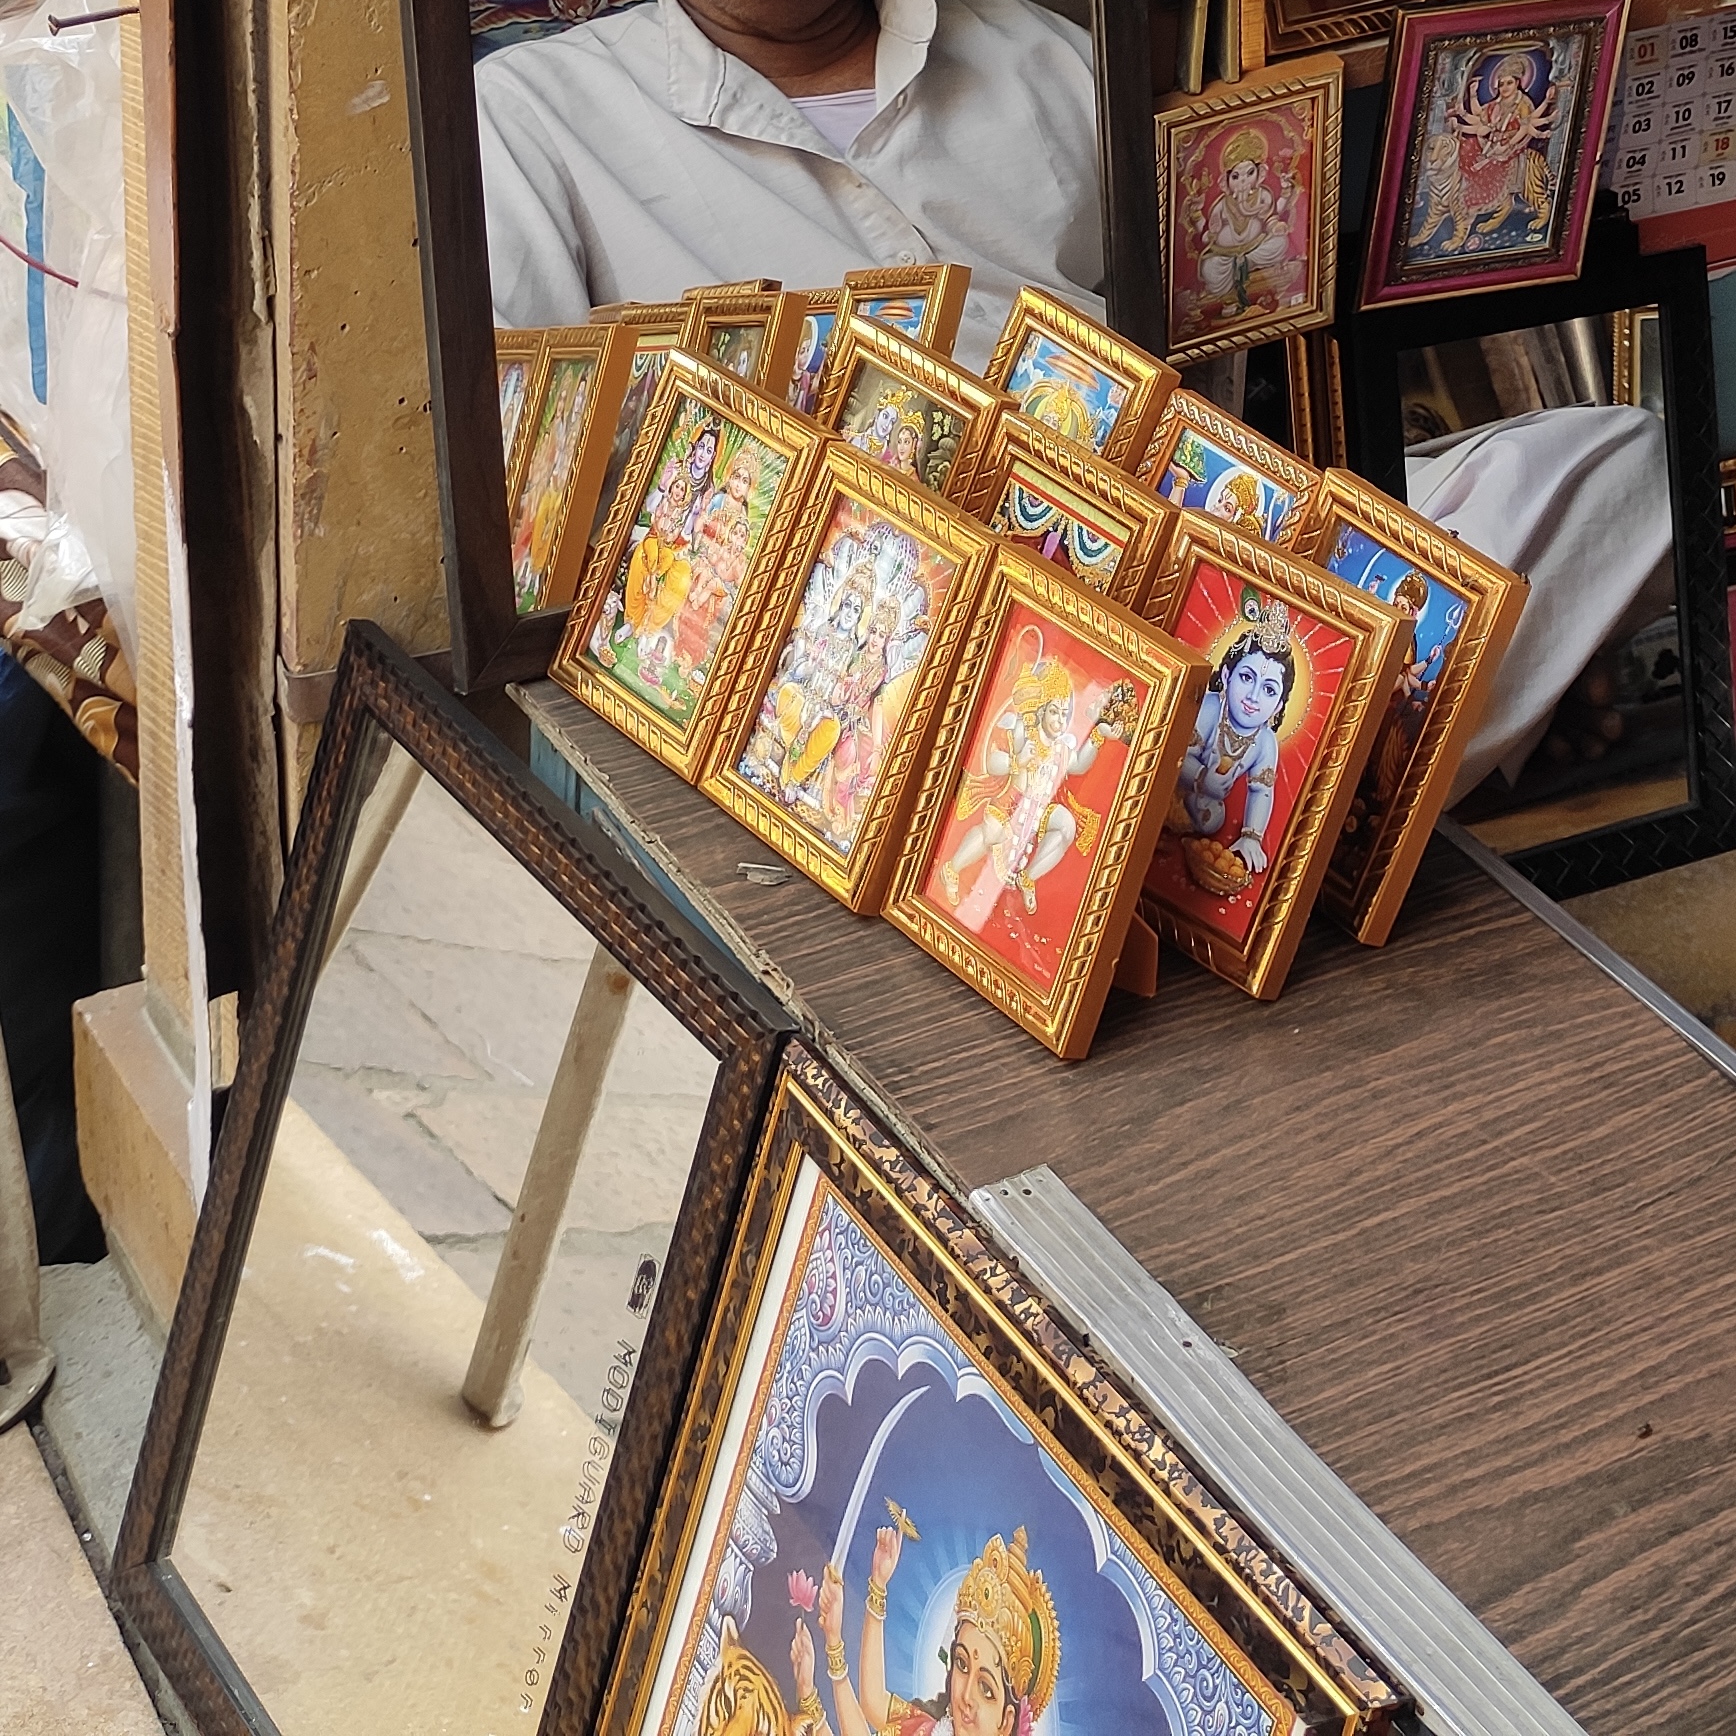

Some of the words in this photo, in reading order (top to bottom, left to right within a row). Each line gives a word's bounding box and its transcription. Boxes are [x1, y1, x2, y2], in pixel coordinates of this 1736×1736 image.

[1637, 42, 1655, 59] 01
[1680, 33, 1699, 50] 08
[1635, 80, 1655, 97] 02
[1676, 70, 1695, 88] 09
[1719, 62, 1735, 78] 16
[1632, 117, 1651, 134] 03
[1674, 108, 1692, 124] 10
[1716, 98, 1733, 115] 17
[1625, 153, 1647, 169] 04
[1670, 143, 1688, 161] 11
[1714, 134, 1731, 151] 18
[1621, 188, 1642, 205] 05
[1666, 179, 1685, 196] 12
[1709, 170, 1727, 188] 19
[563, 1339, 638, 1555] MODIGUARD
[519, 1573, 572, 1713] Mirror
